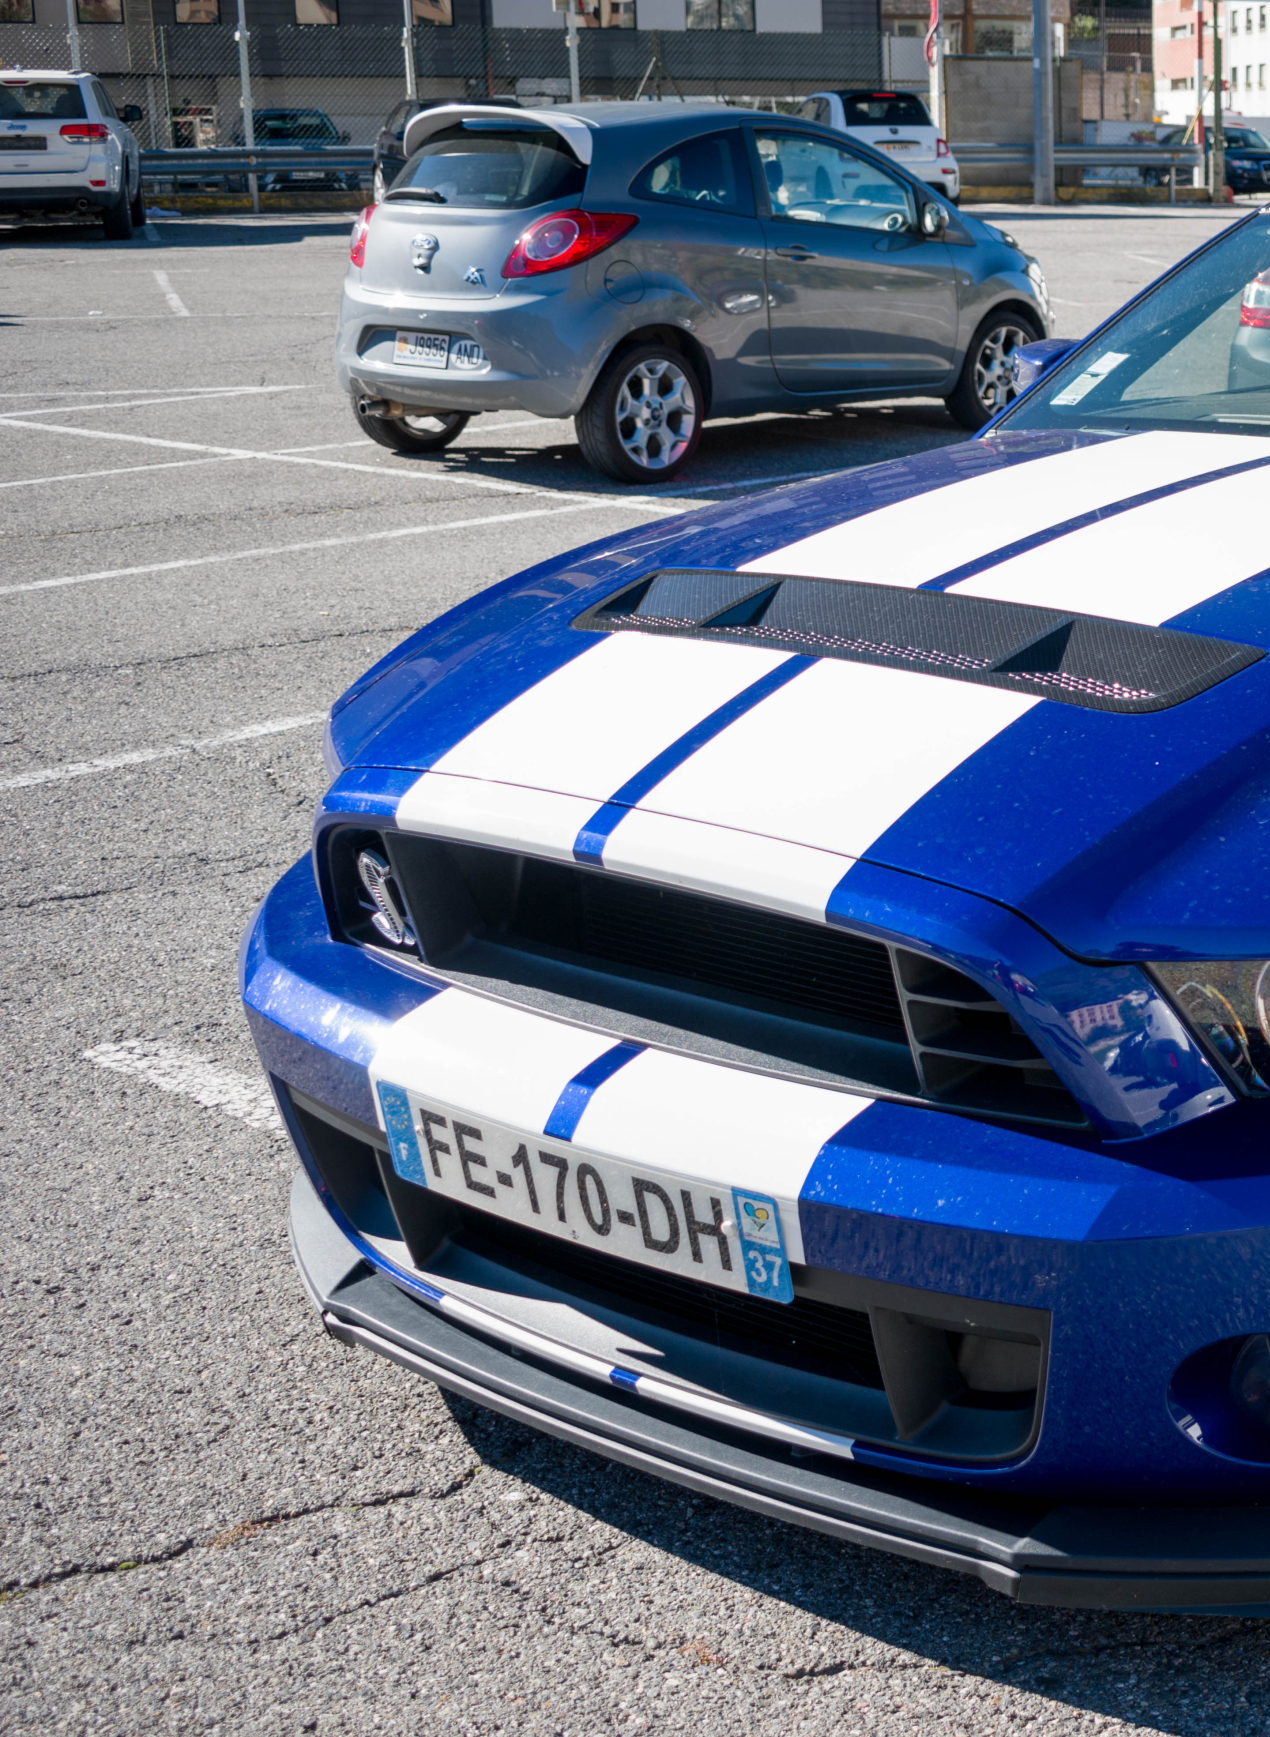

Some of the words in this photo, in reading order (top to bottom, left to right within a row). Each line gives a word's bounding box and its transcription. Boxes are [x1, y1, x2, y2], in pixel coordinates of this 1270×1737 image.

[409, 335, 447, 358] J9956
[455, 343, 480, 365] AND
[398, 1141, 409, 1162] F
[419, 1108, 734, 1272] FE-170-DH
[748, 1250, 782, 1287] 37
